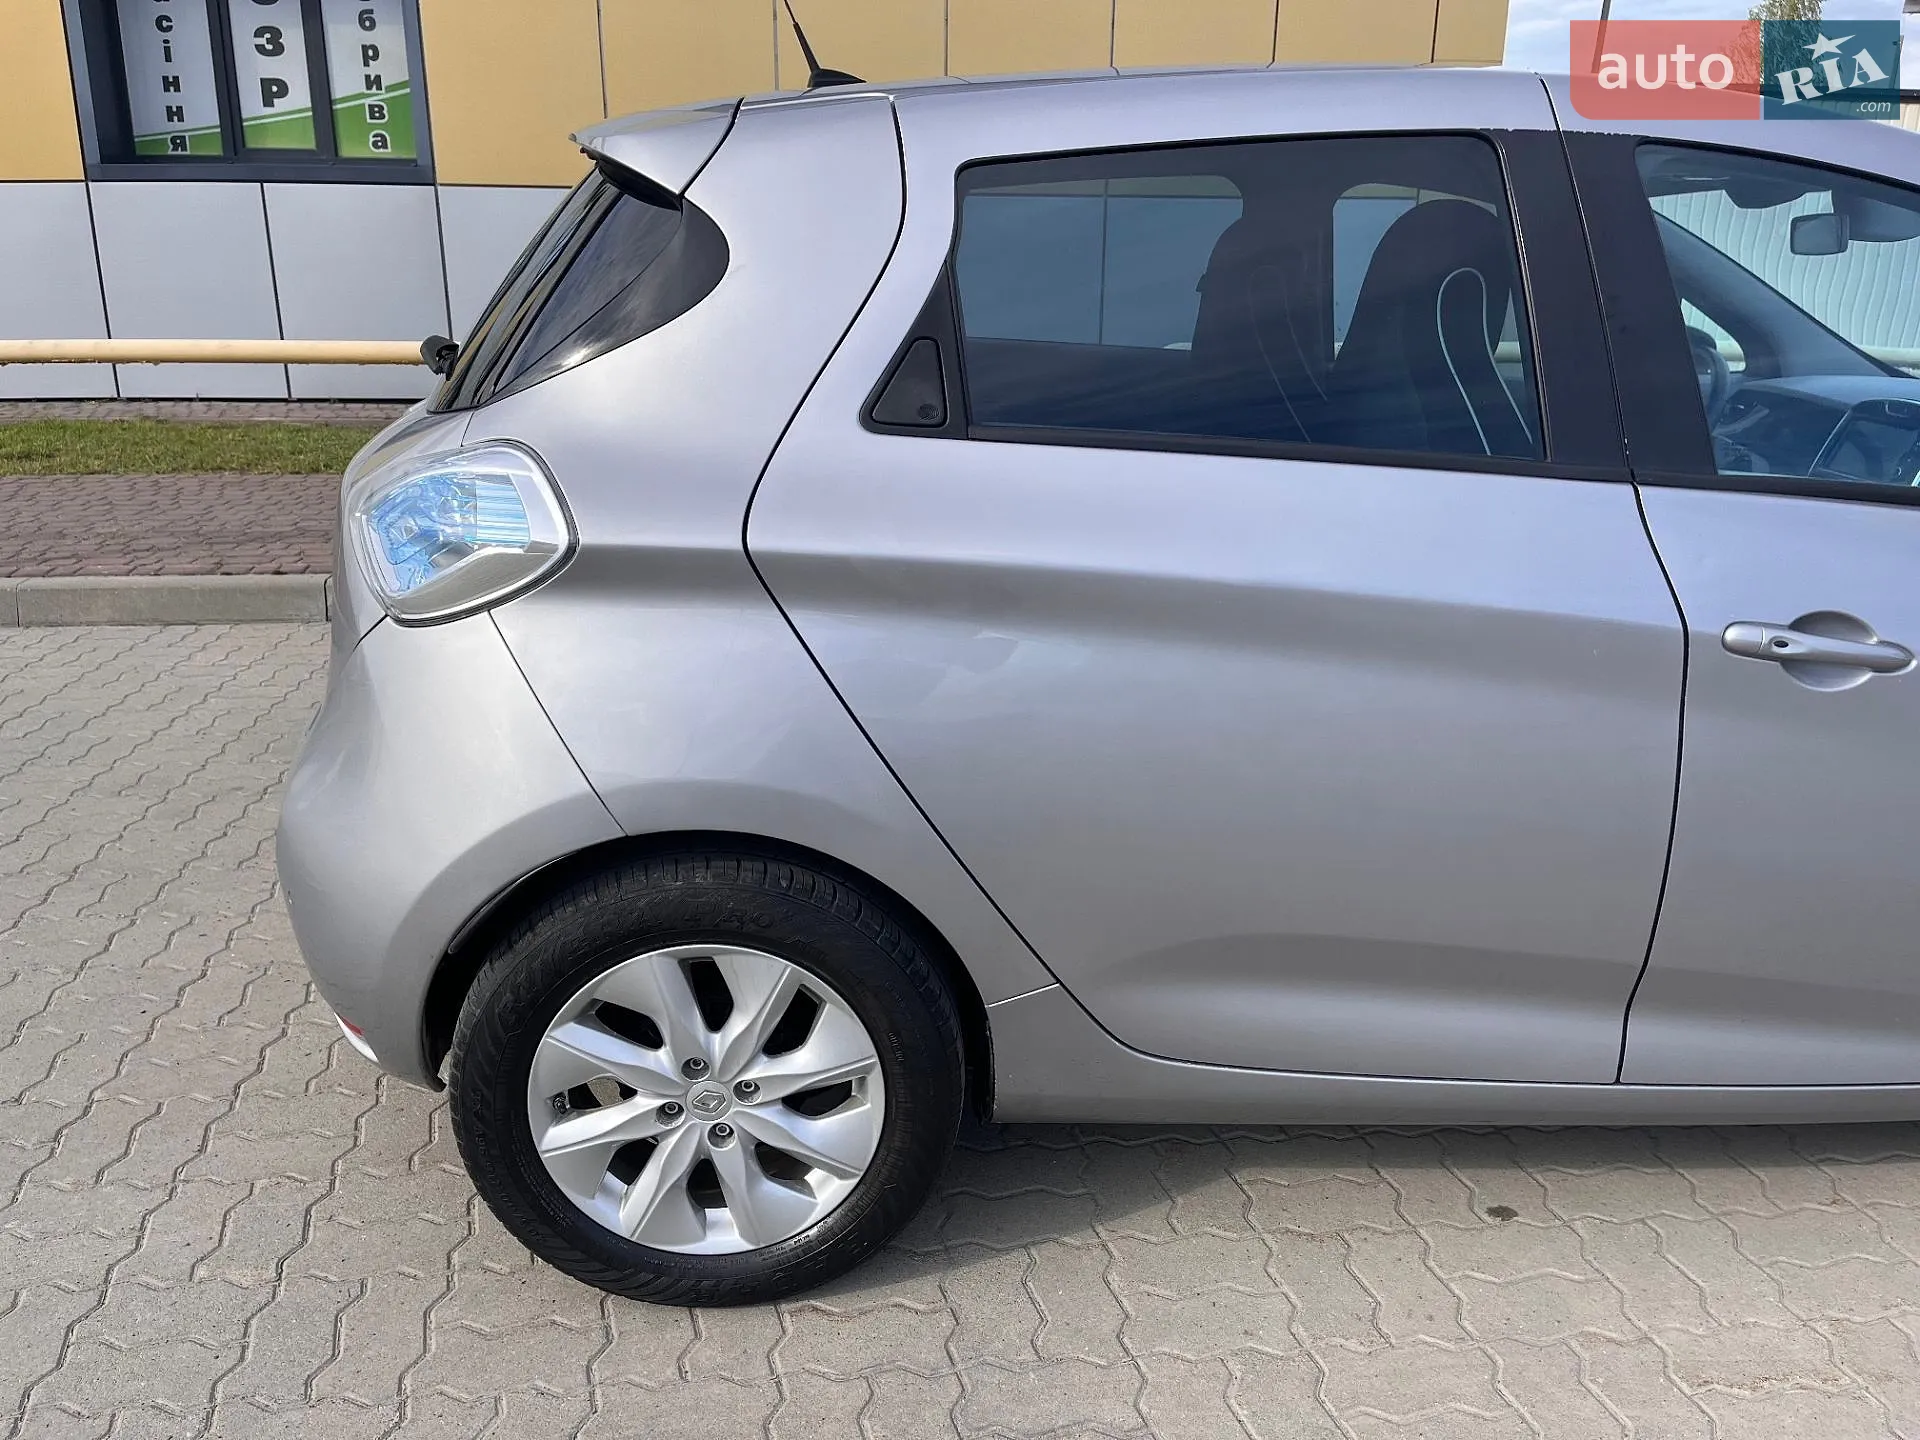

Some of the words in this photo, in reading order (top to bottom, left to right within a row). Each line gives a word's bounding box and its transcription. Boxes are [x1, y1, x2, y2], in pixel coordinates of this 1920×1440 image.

[154, 0, 189, 152] сіння
[253, 0, 289, 108] ЗР
[357, 0, 389, 151] брива
